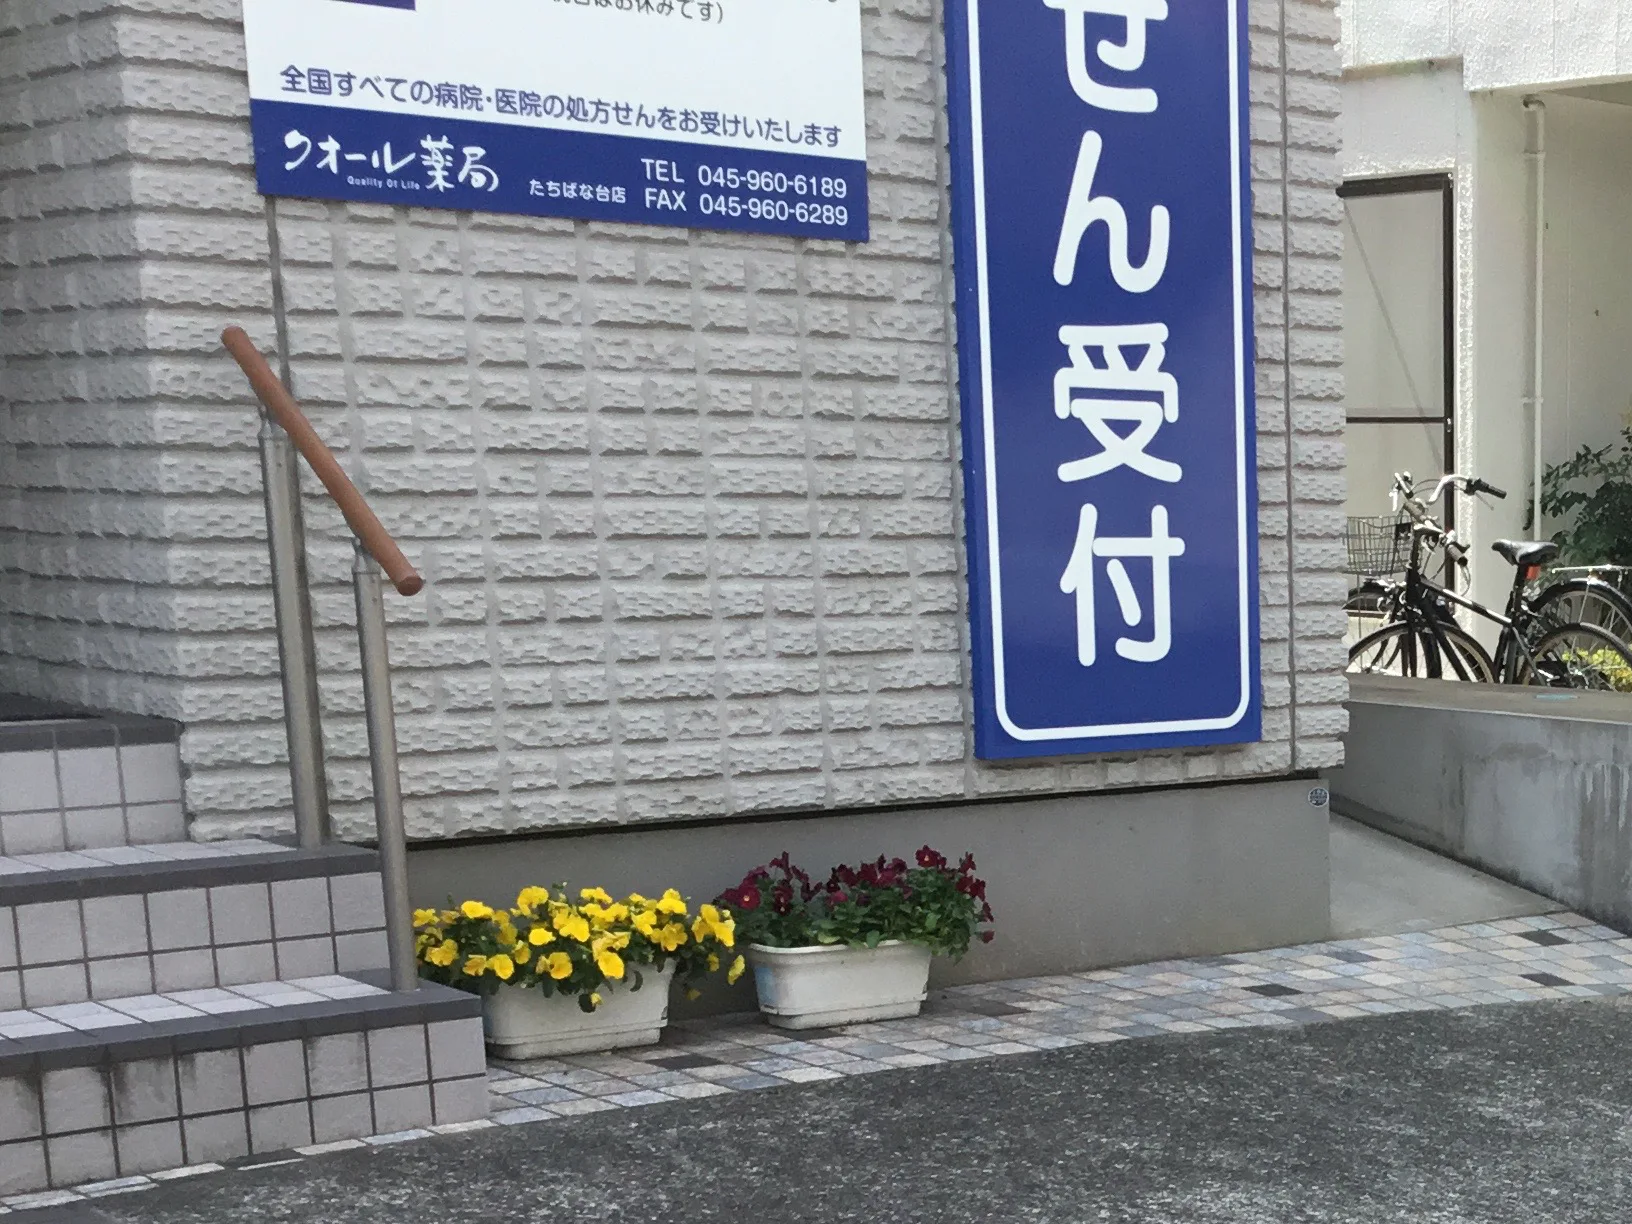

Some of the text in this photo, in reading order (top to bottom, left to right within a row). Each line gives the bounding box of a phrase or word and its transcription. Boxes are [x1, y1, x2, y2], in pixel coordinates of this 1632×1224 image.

[284, 129, 499, 193] クオール薬局
[641, 158, 847, 199] TEL 045-960-6189
[347, 175, 383, 189] Quality
[401, 180, 421, 190] Life
[529, 179, 626, 204] たちばな台店
[645, 188, 848, 226] FAX 045-960-6289
